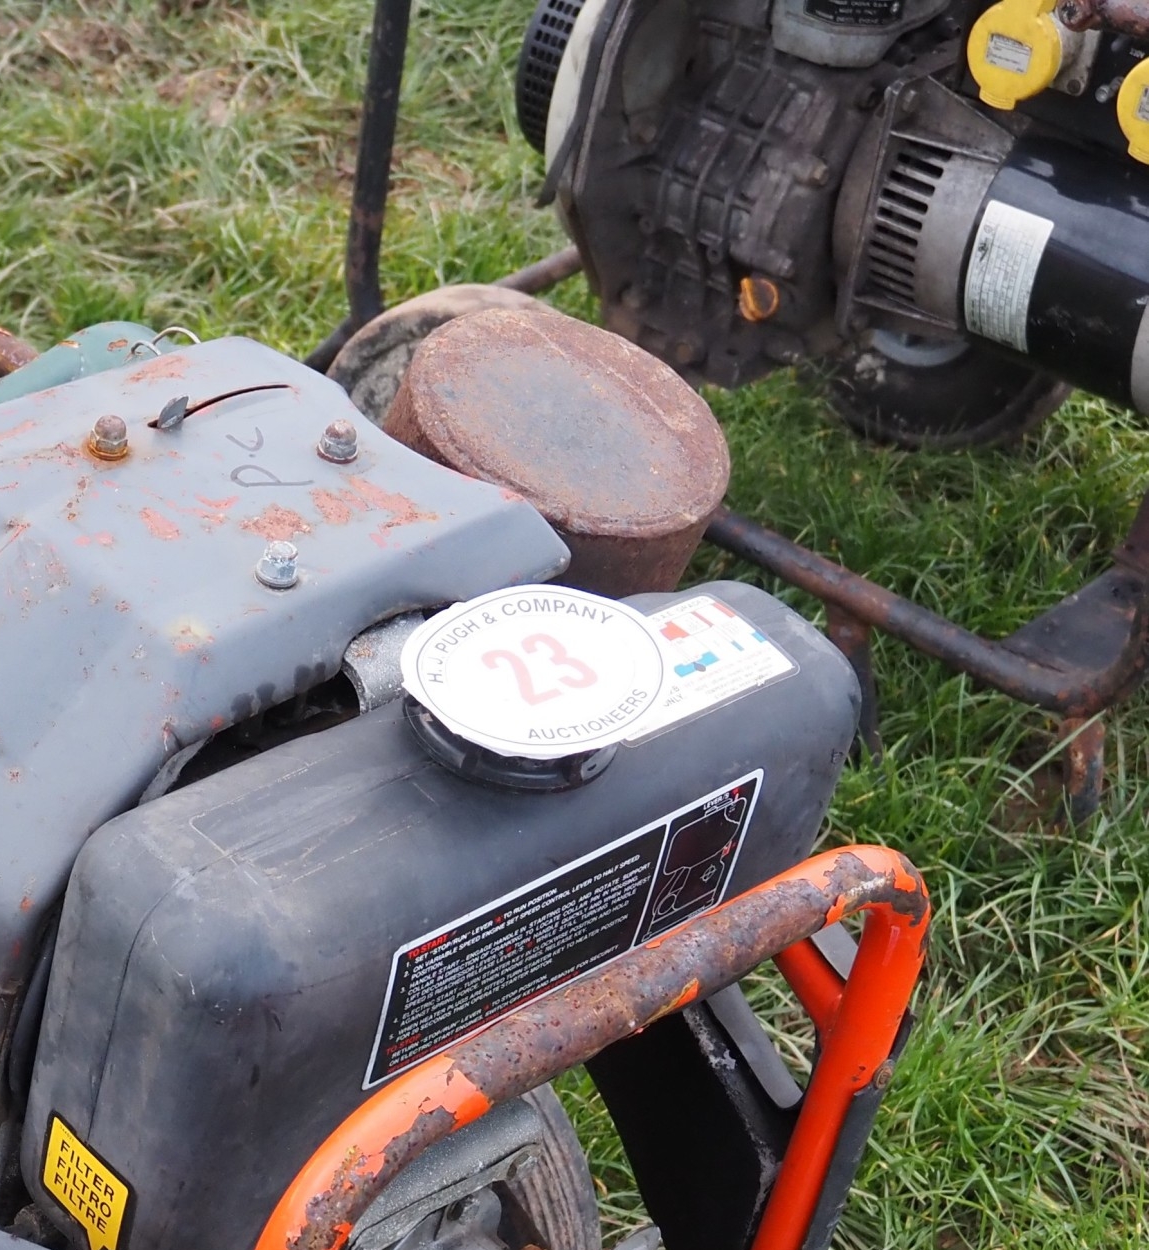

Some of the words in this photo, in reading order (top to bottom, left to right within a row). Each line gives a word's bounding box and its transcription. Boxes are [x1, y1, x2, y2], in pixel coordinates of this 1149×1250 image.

[435, 619, 480, 654] PUGH
[481, 611, 498, 625] &
[501, 598, 615, 625] COMPANY
[481, 632, 599, 706] 23
[528, 688, 648, 740] AUCTIONEERS
[457, 933, 481, 951] SPEED
[480, 921, 505, 939] ENGINE
[505, 914, 519, 927] SET
[519, 903, 541, 920] SPEED
[540, 888, 571, 909] CONTROL
[571, 877, 593, 893] LEVER
[592, 872, 602, 883] TO
[601, 864, 618, 878] HALF
[618, 853, 641, 870] SPEED
[470, 918, 494, 936] LEVER
[503, 909, 513, 919] TO
[511, 902, 527, 915] RUN
[406, 946, 420, 960] TO
[420, 932, 448, 953] START
[57, 1156, 112, 1218] FILTRO
[60, 1139, 115, 1202] FILTER
[54, 1172, 107, 1235] FILTRE
